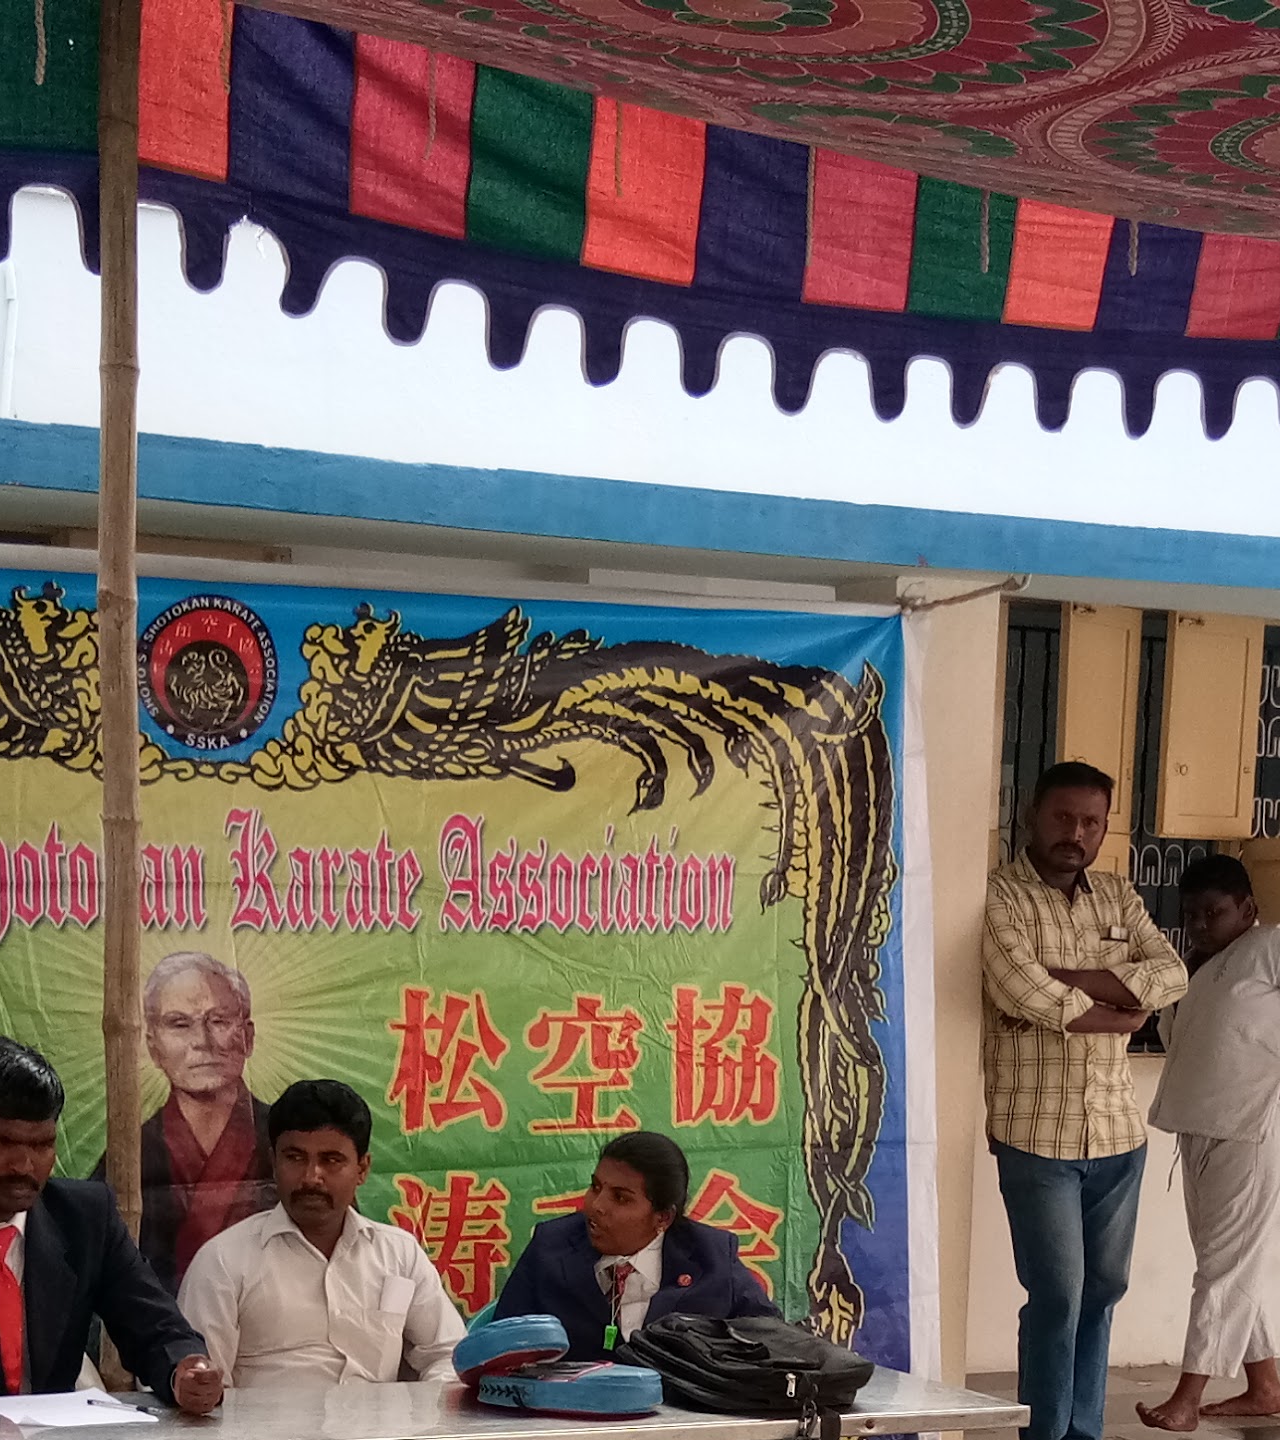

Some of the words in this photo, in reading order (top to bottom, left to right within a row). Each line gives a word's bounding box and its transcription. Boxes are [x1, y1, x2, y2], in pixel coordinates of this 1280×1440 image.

[143, 597, 210, 643] SHOTOKAN
[213, 597, 262, 632] KARATE
[138, 654, 159, 717] SHOTOS
[253, 631, 277, 724] ASSOCIATION
[185, 733, 230, 749] SSKA
[224, 808, 422, 932] Karate
[438, 813, 735, 932] Association
